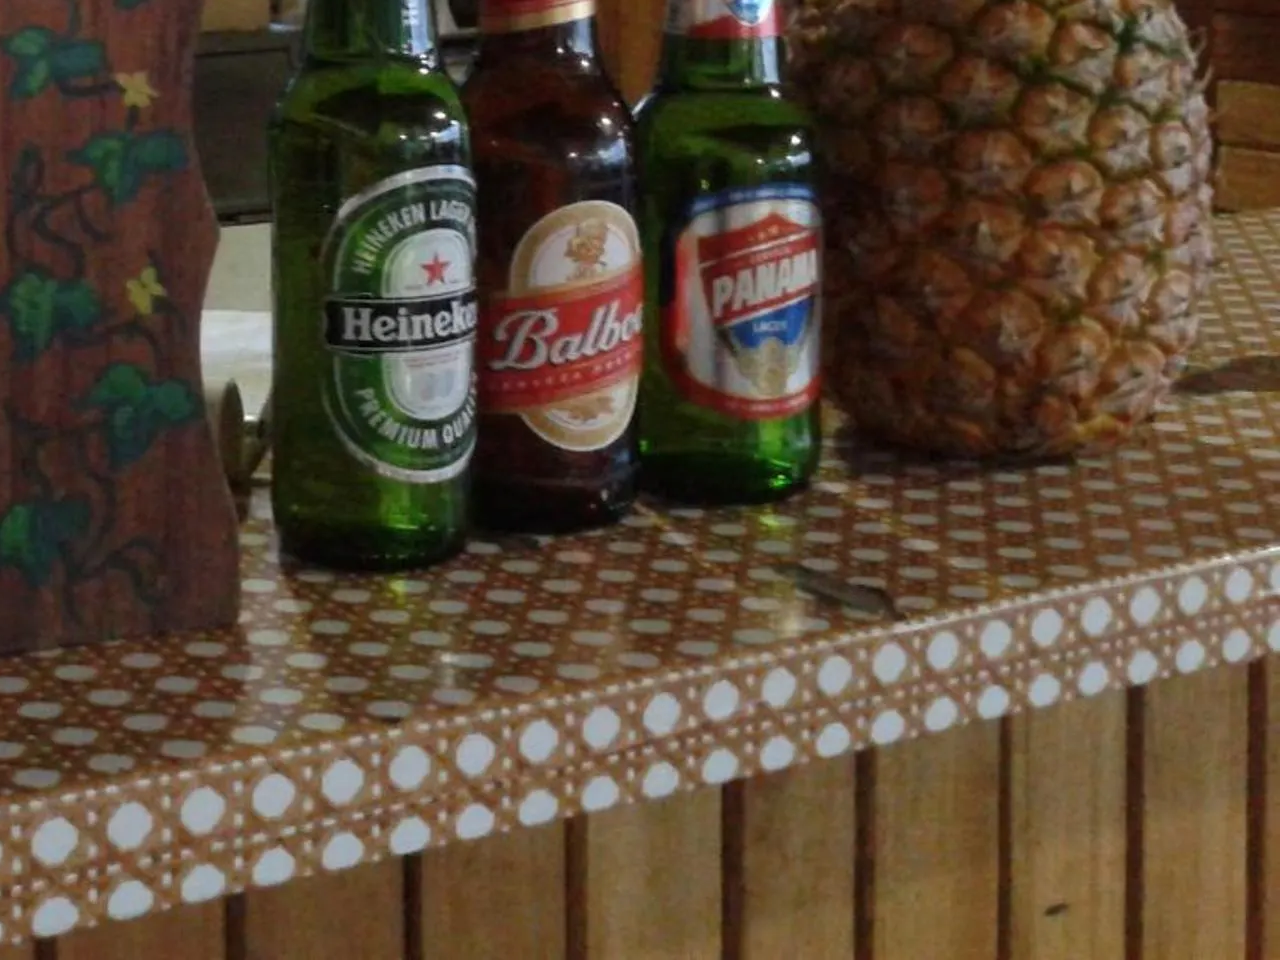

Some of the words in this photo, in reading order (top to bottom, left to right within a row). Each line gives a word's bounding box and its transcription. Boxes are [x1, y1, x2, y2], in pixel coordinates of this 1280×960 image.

[351, 201, 426, 275] HEINEKEN
[341, 300, 477, 341] Heineke
[489, 298, 643, 371] Balbo
[355, 387, 440, 449] PREMIUM
